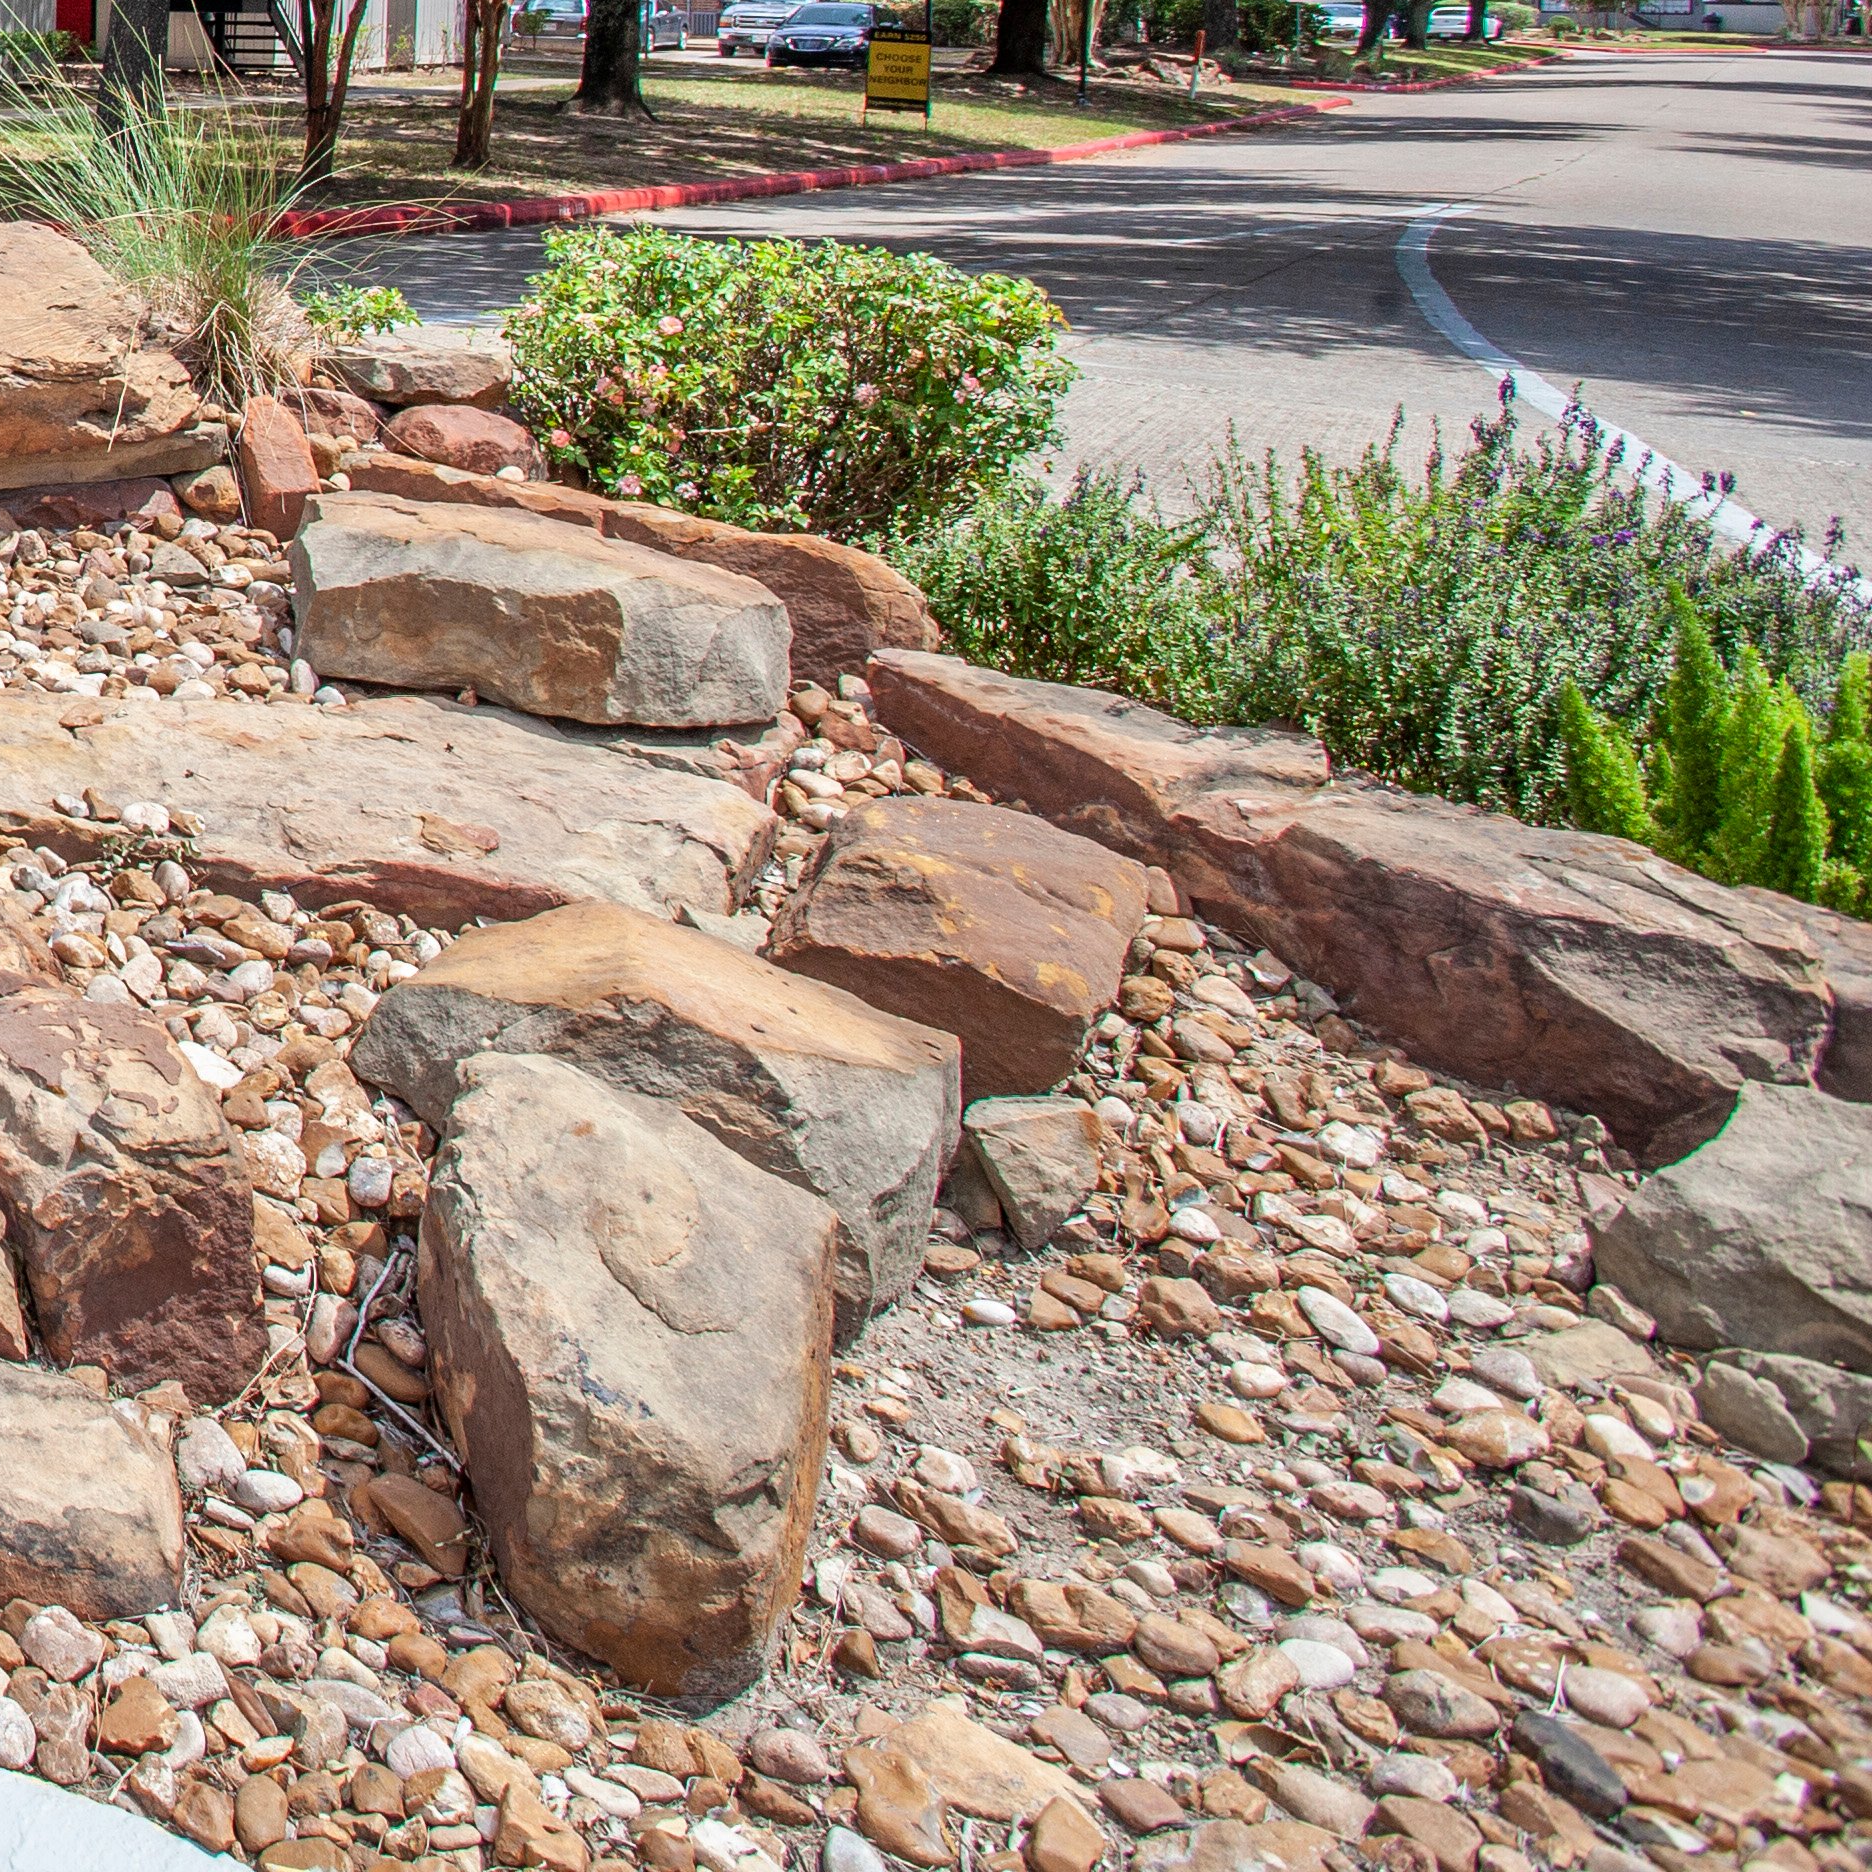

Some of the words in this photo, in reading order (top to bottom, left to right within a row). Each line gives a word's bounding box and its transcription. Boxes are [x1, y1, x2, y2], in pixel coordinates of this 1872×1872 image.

[874, 31, 902, 40] EARN
[876, 53, 922, 63] CHOOSE
[883, 64, 913, 73] YOUR
[869, 75, 927, 86] NEIGHBOR
